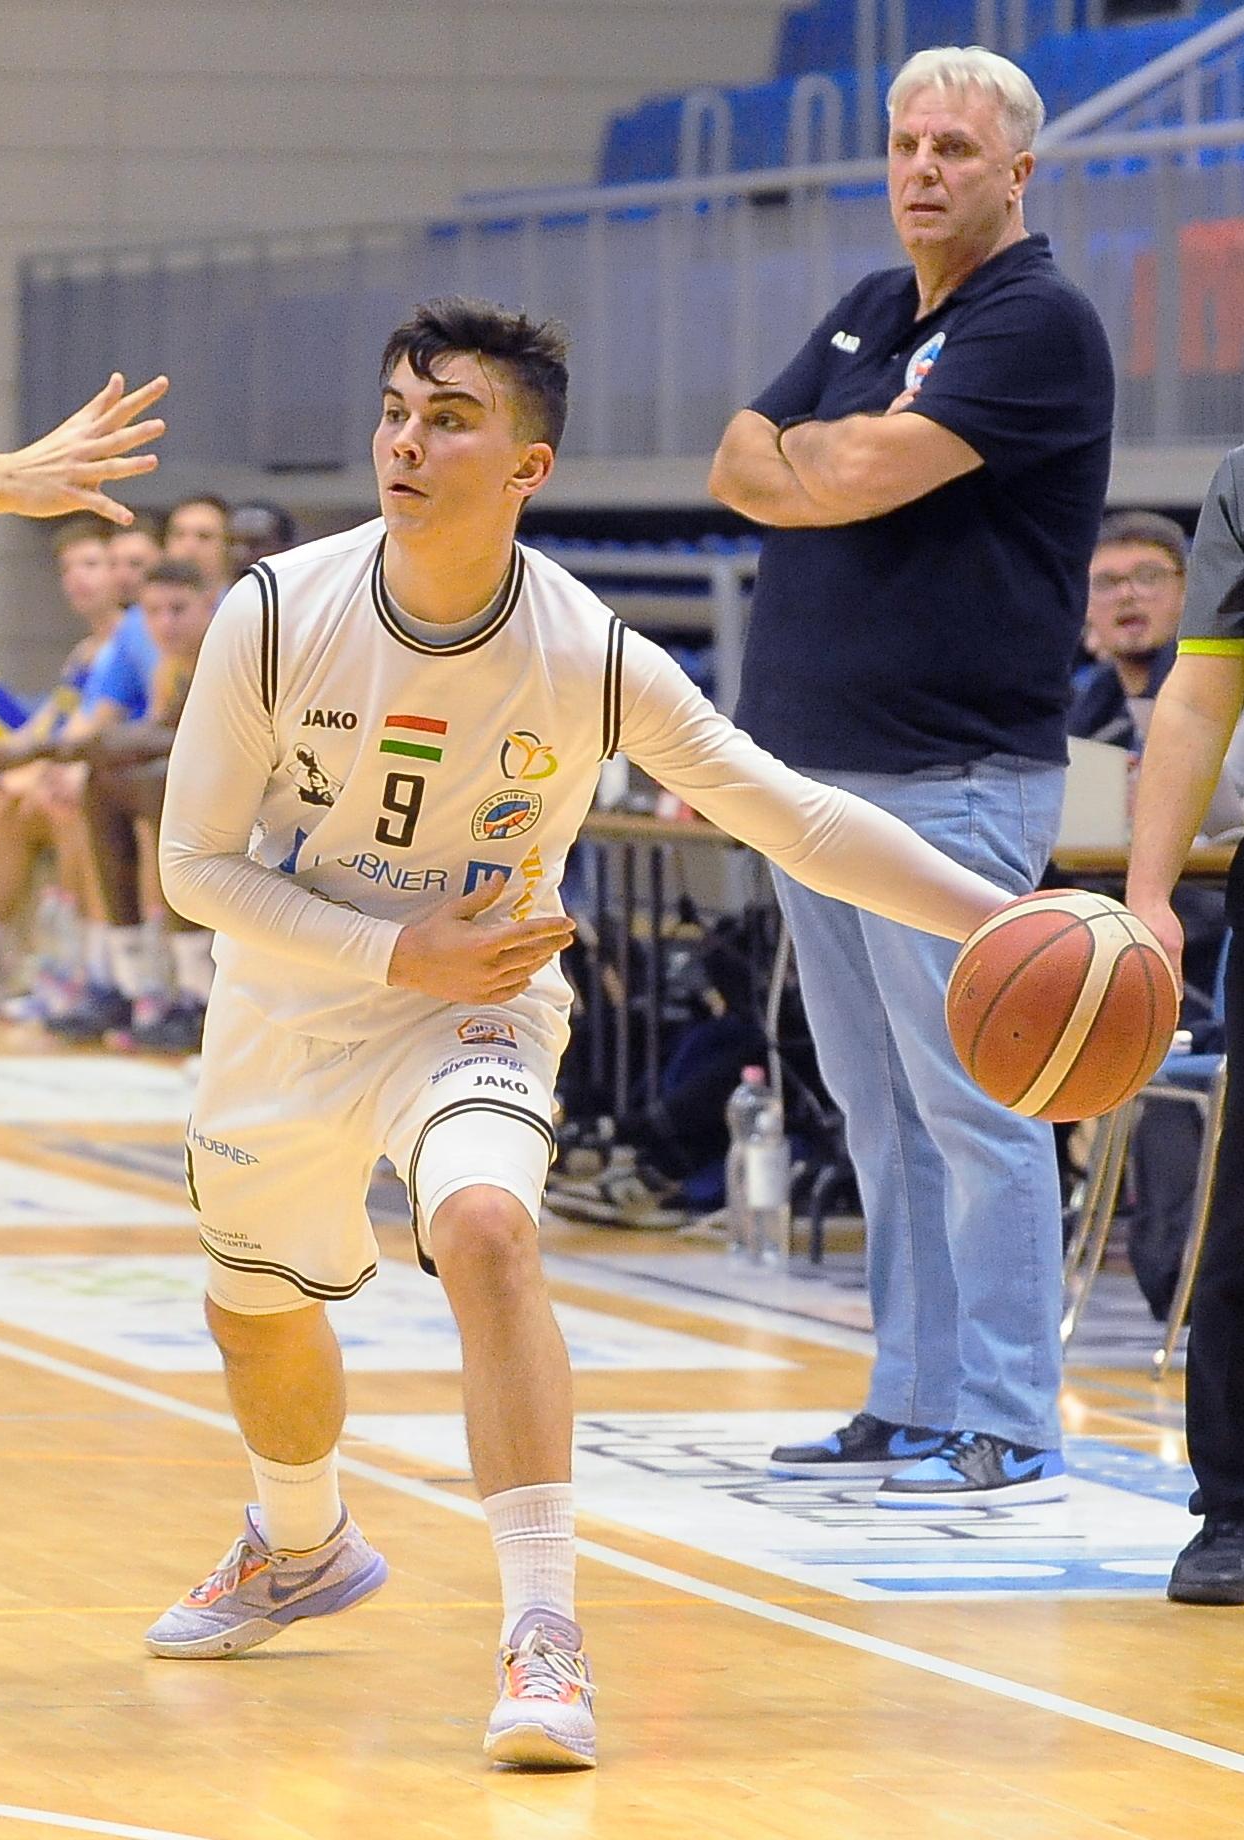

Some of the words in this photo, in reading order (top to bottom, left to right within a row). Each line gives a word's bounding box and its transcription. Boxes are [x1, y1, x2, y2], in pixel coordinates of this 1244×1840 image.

[301, 709, 358, 730] JAKO
[374, 772, 425, 848] 9
[314, 852, 448, 892] BNER
[473, 1075, 529, 1095] JAKO
